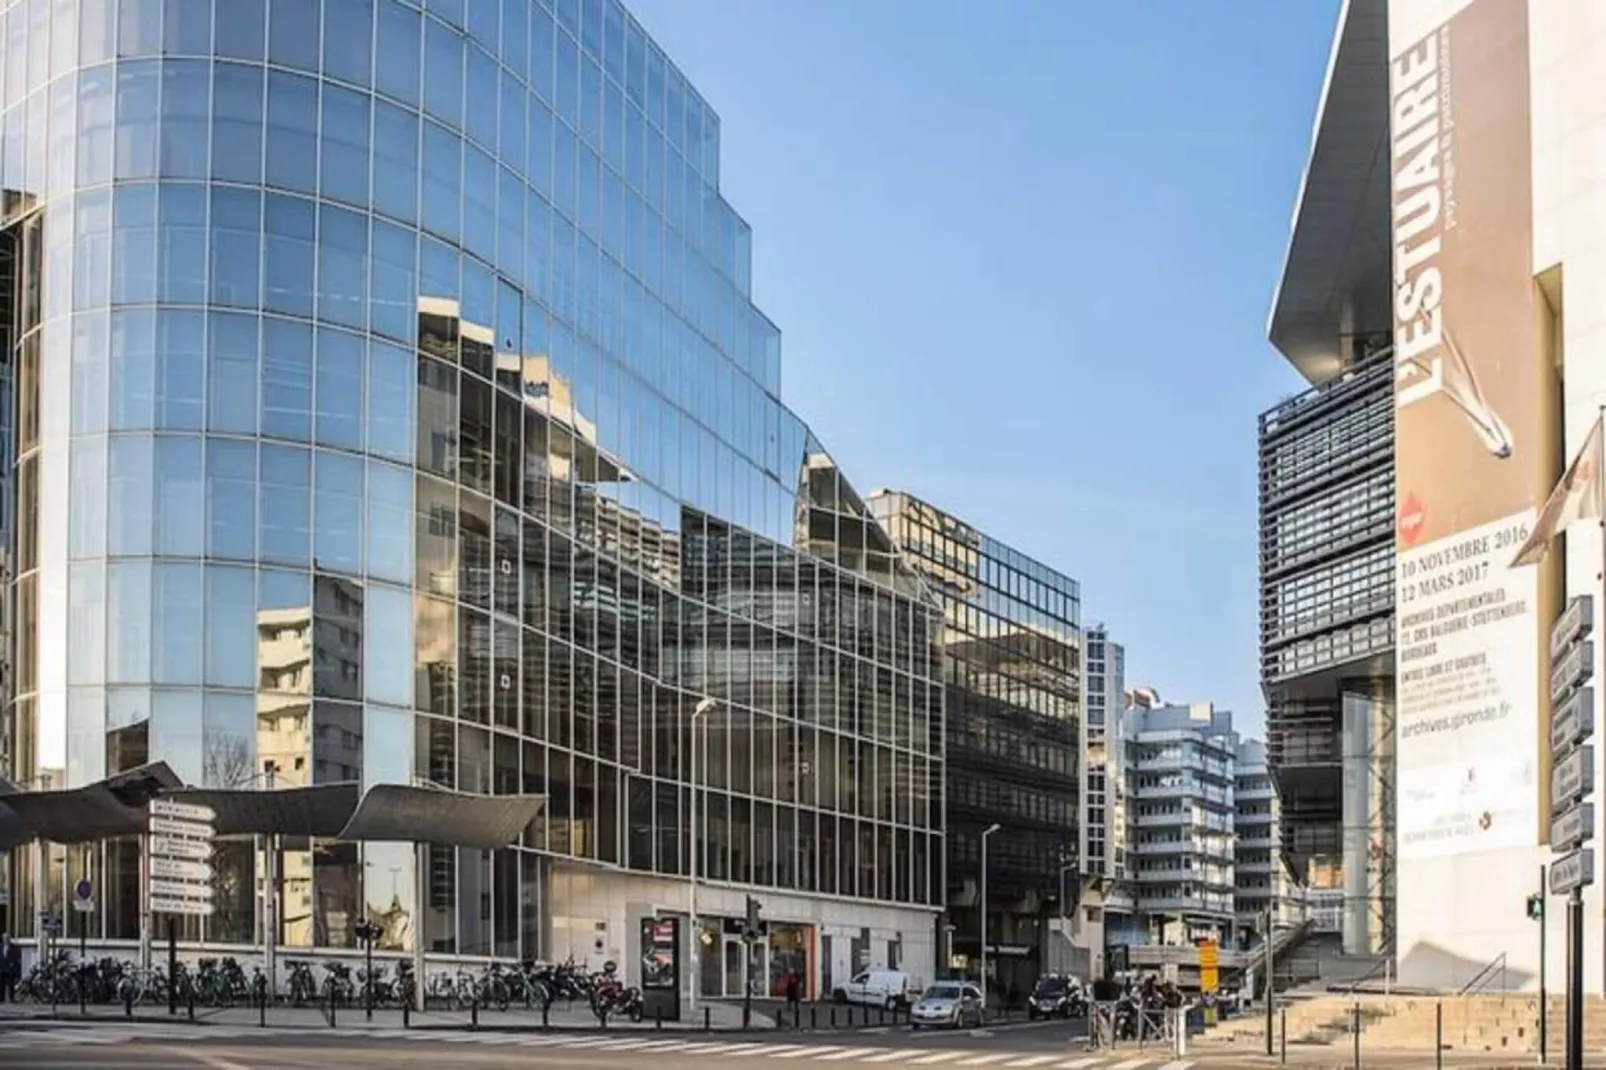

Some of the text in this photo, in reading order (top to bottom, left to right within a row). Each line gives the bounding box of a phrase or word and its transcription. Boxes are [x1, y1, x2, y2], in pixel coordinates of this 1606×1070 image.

[1402, 525, 1528, 578] 10 NOVEMBRE 2016
[1402, 561, 1488, 602] 12 MARS 2017
